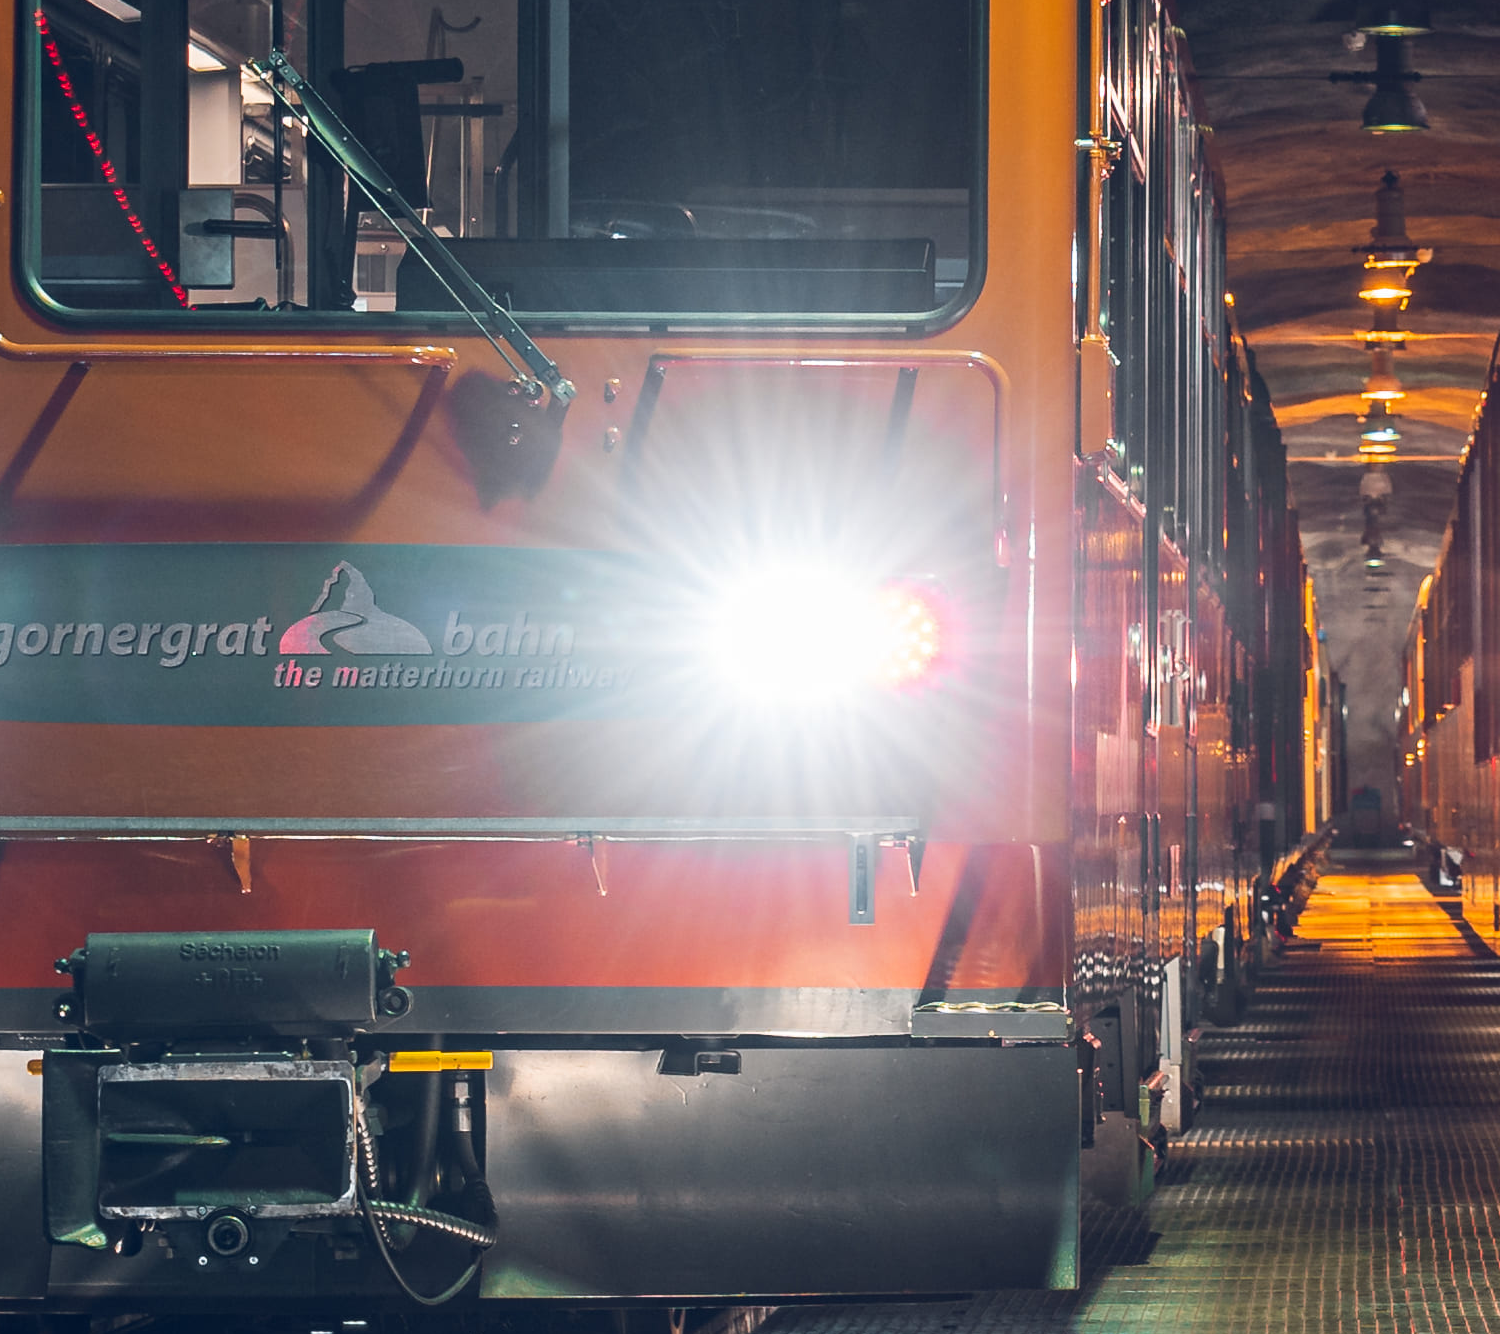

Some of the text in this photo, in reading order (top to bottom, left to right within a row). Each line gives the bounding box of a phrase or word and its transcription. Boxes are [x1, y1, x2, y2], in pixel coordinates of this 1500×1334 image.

[442, 610, 576, 657] bahn
[274, 659, 636, 697] the matterhorn railway
[180, 940, 280, 962] Sécheron
